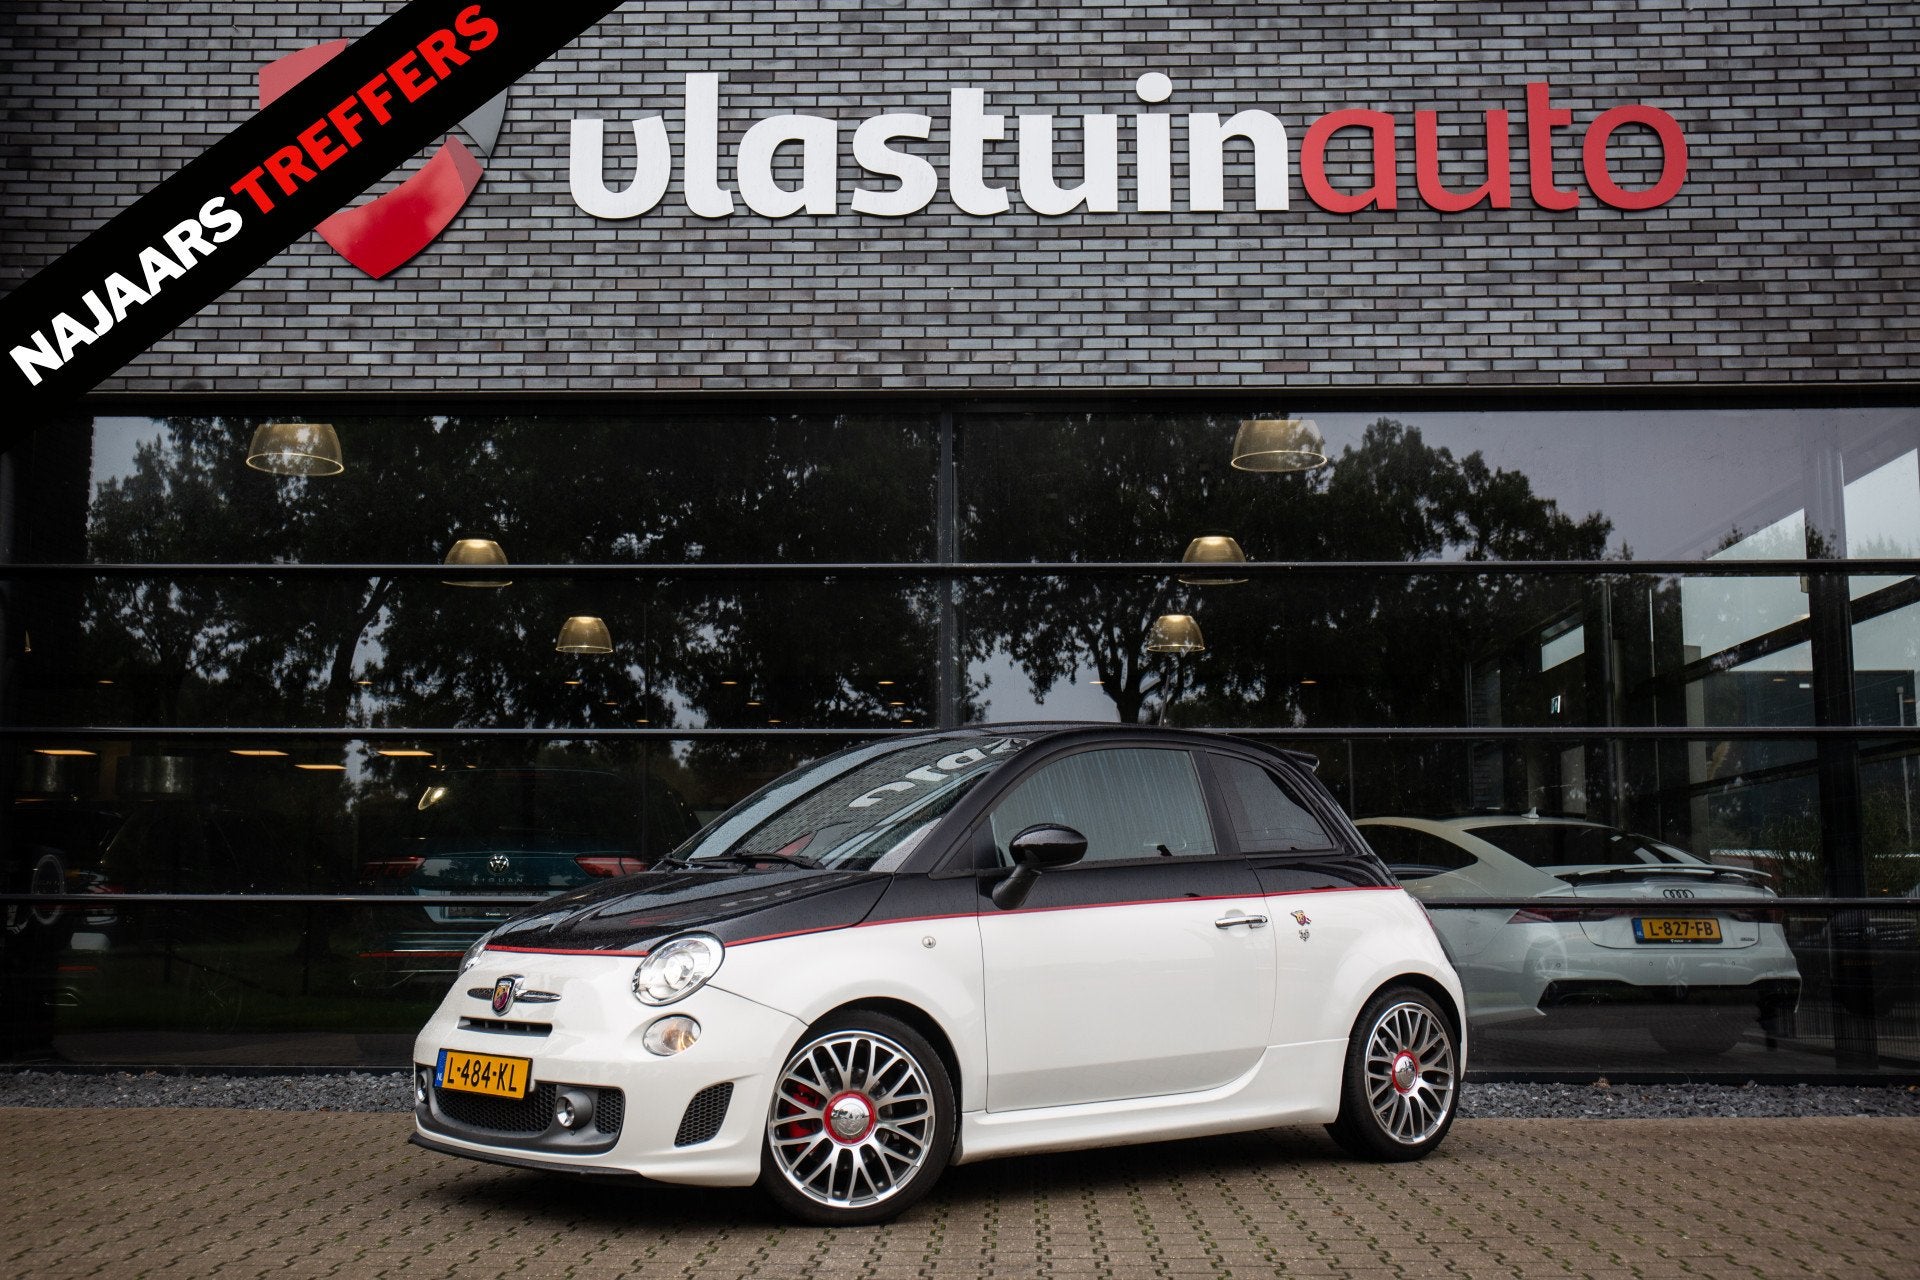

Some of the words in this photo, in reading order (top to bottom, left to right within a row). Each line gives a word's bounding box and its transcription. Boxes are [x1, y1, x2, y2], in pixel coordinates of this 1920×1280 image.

[1648, 921, 1714, 938] L-827-FB
[436, 1072, 443, 1081] NL
[447, 1056, 518, 1093] L-484-KL
